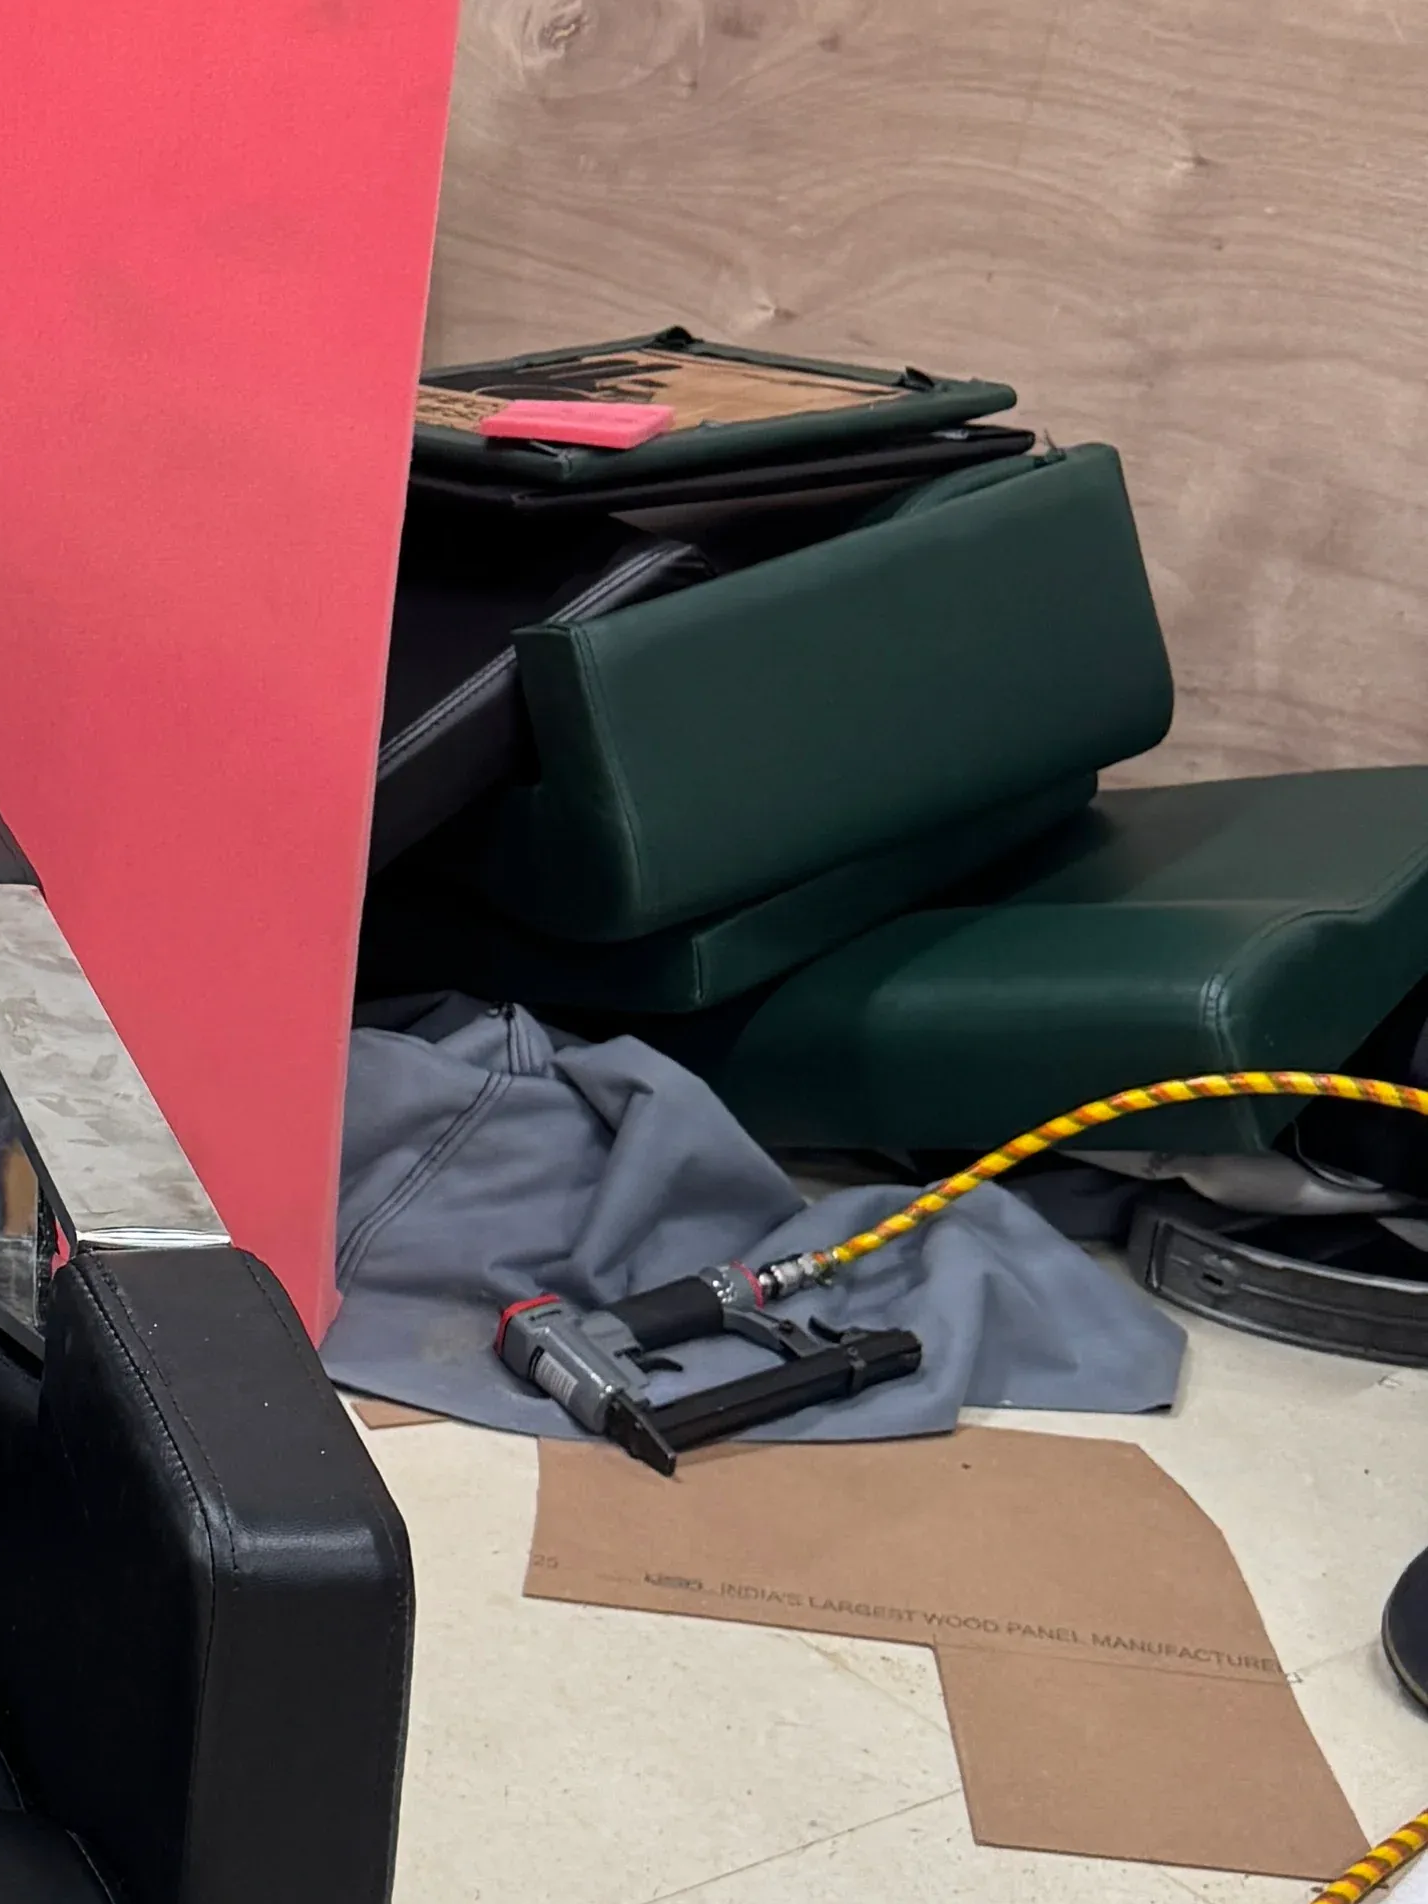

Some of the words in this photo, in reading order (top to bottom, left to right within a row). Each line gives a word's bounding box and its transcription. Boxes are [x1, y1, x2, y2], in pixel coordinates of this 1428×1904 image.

[719, 1581, 802, 1607] INDIA'S
[807, 1596, 917, 1623] LARGEST
[920, 1612, 1000, 1634] WOOD
[1006, 1623, 1079, 1644] PANEL
